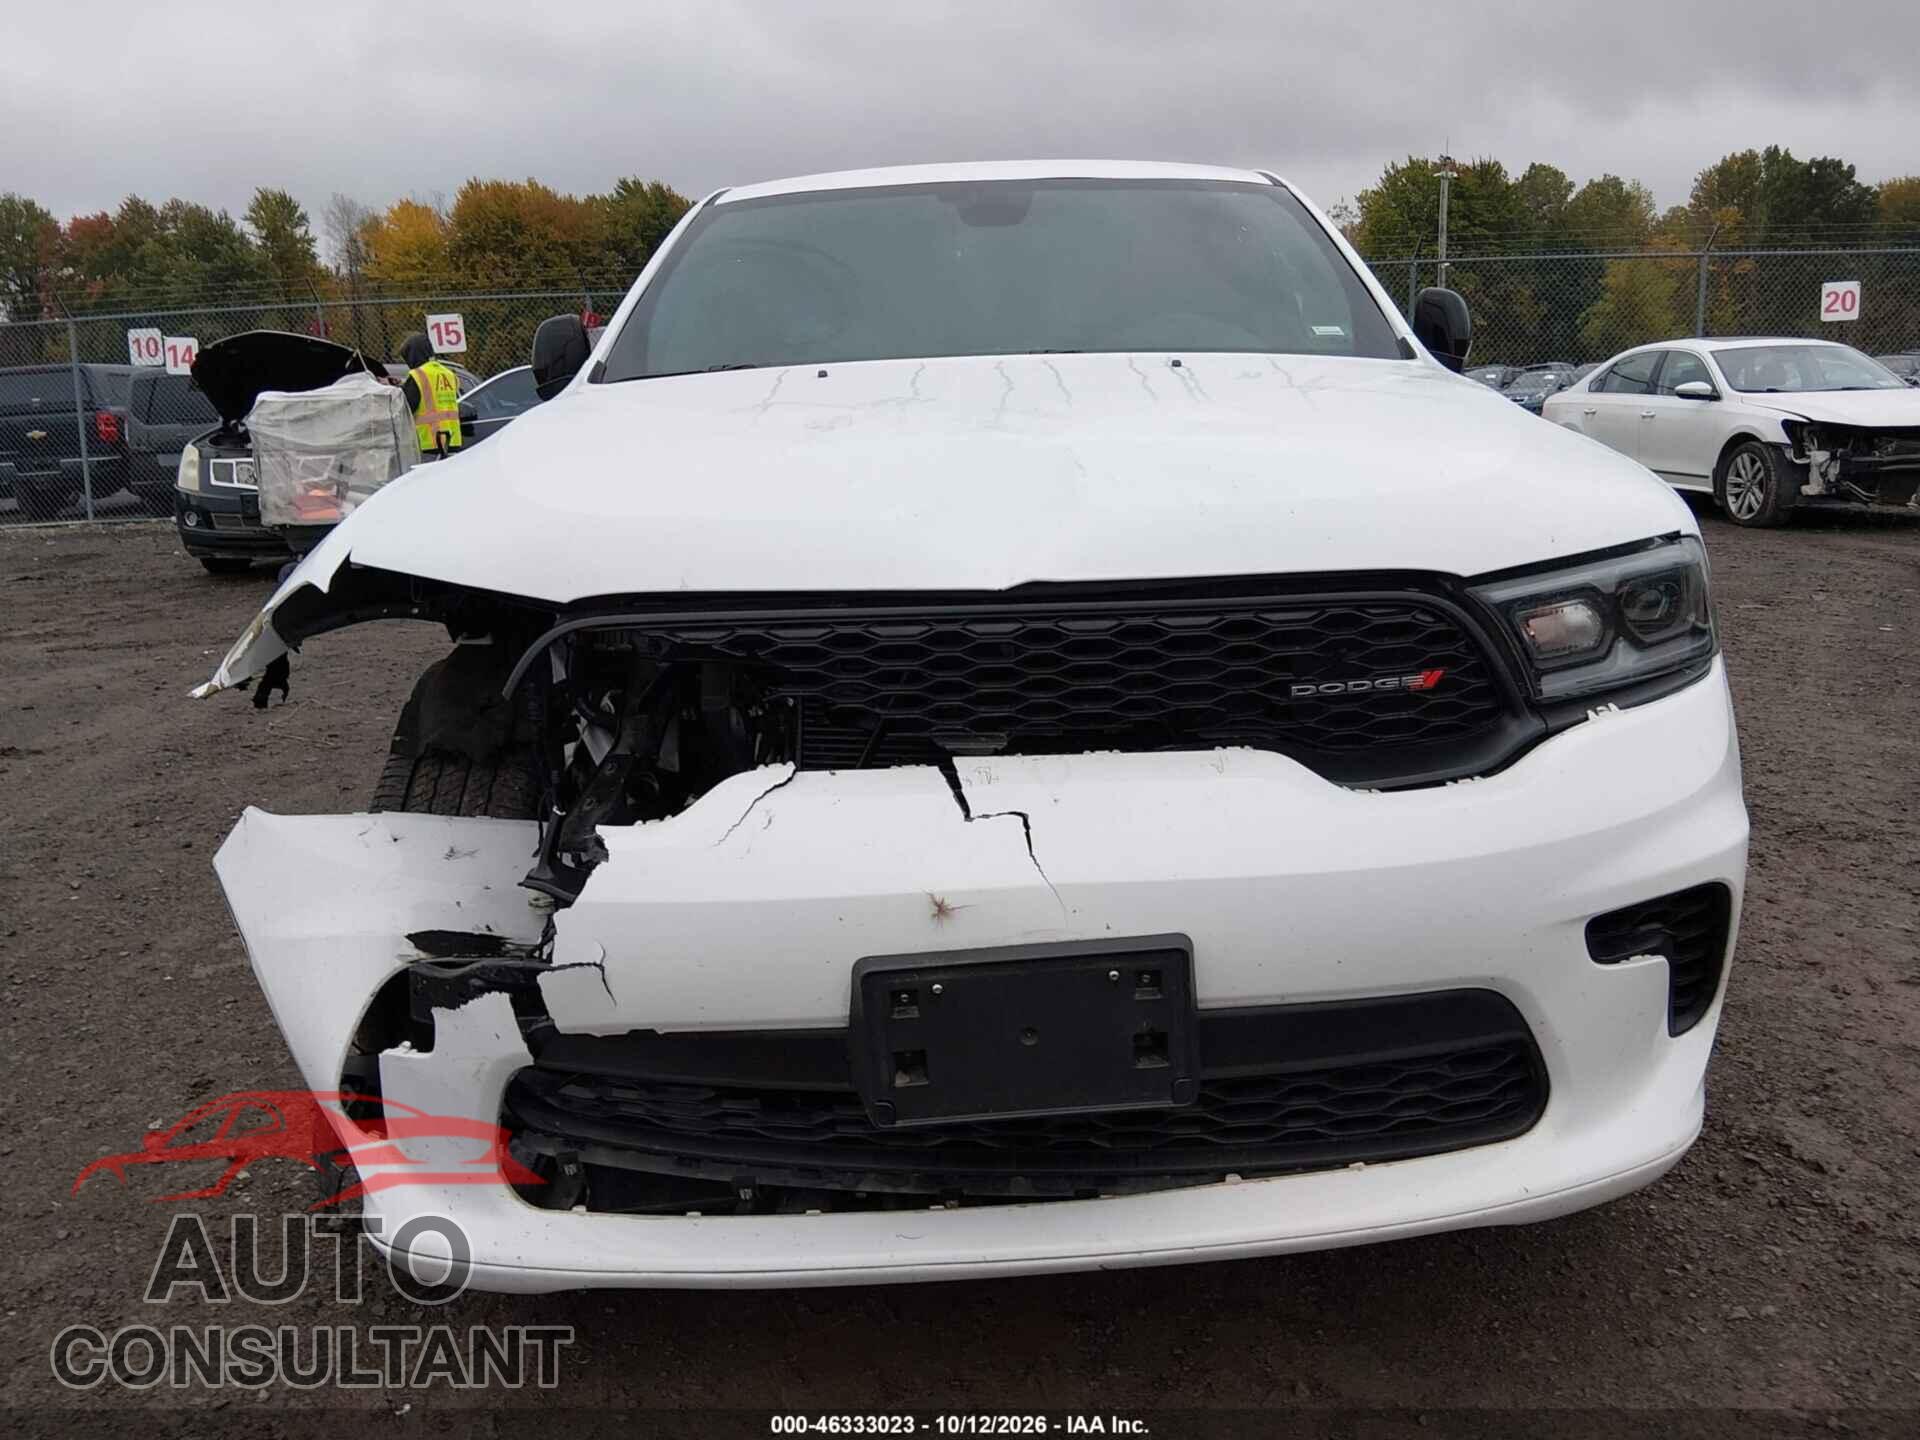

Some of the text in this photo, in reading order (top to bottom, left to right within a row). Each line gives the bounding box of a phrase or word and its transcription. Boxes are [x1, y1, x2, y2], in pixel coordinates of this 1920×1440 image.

[1824, 290, 1856, 313] 20
[431, 321, 462, 346] 15
[132, 336, 159, 359] 10
[167, 344, 194, 369] 14
[1291, 674, 1425, 697] DODGE
